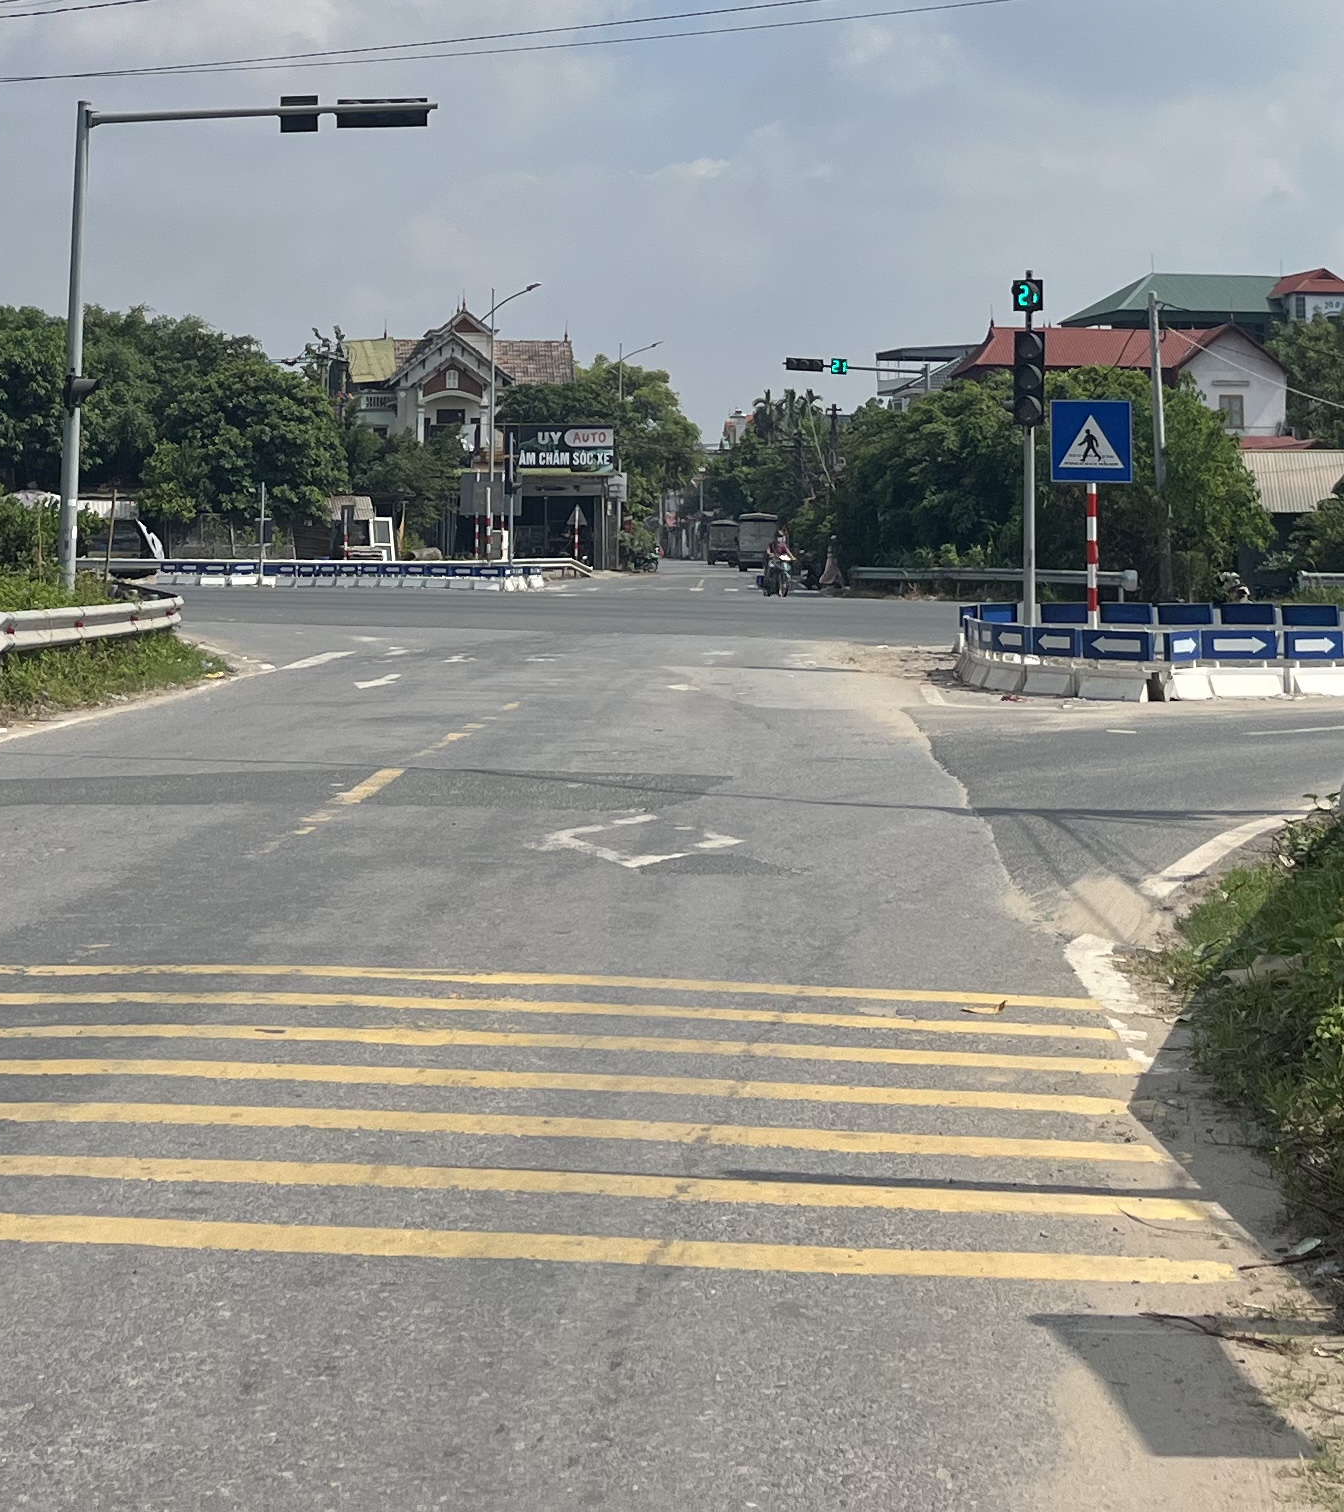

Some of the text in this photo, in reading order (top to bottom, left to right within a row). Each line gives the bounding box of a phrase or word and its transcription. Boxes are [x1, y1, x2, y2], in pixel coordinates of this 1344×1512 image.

[831, 359, 848, 373] 21
[572, 431, 607, 445] AUTO
[539, 450, 570, 465] CHĂM
[572, 450, 594, 465] SÓC
[596, 452, 610, 465] XE
